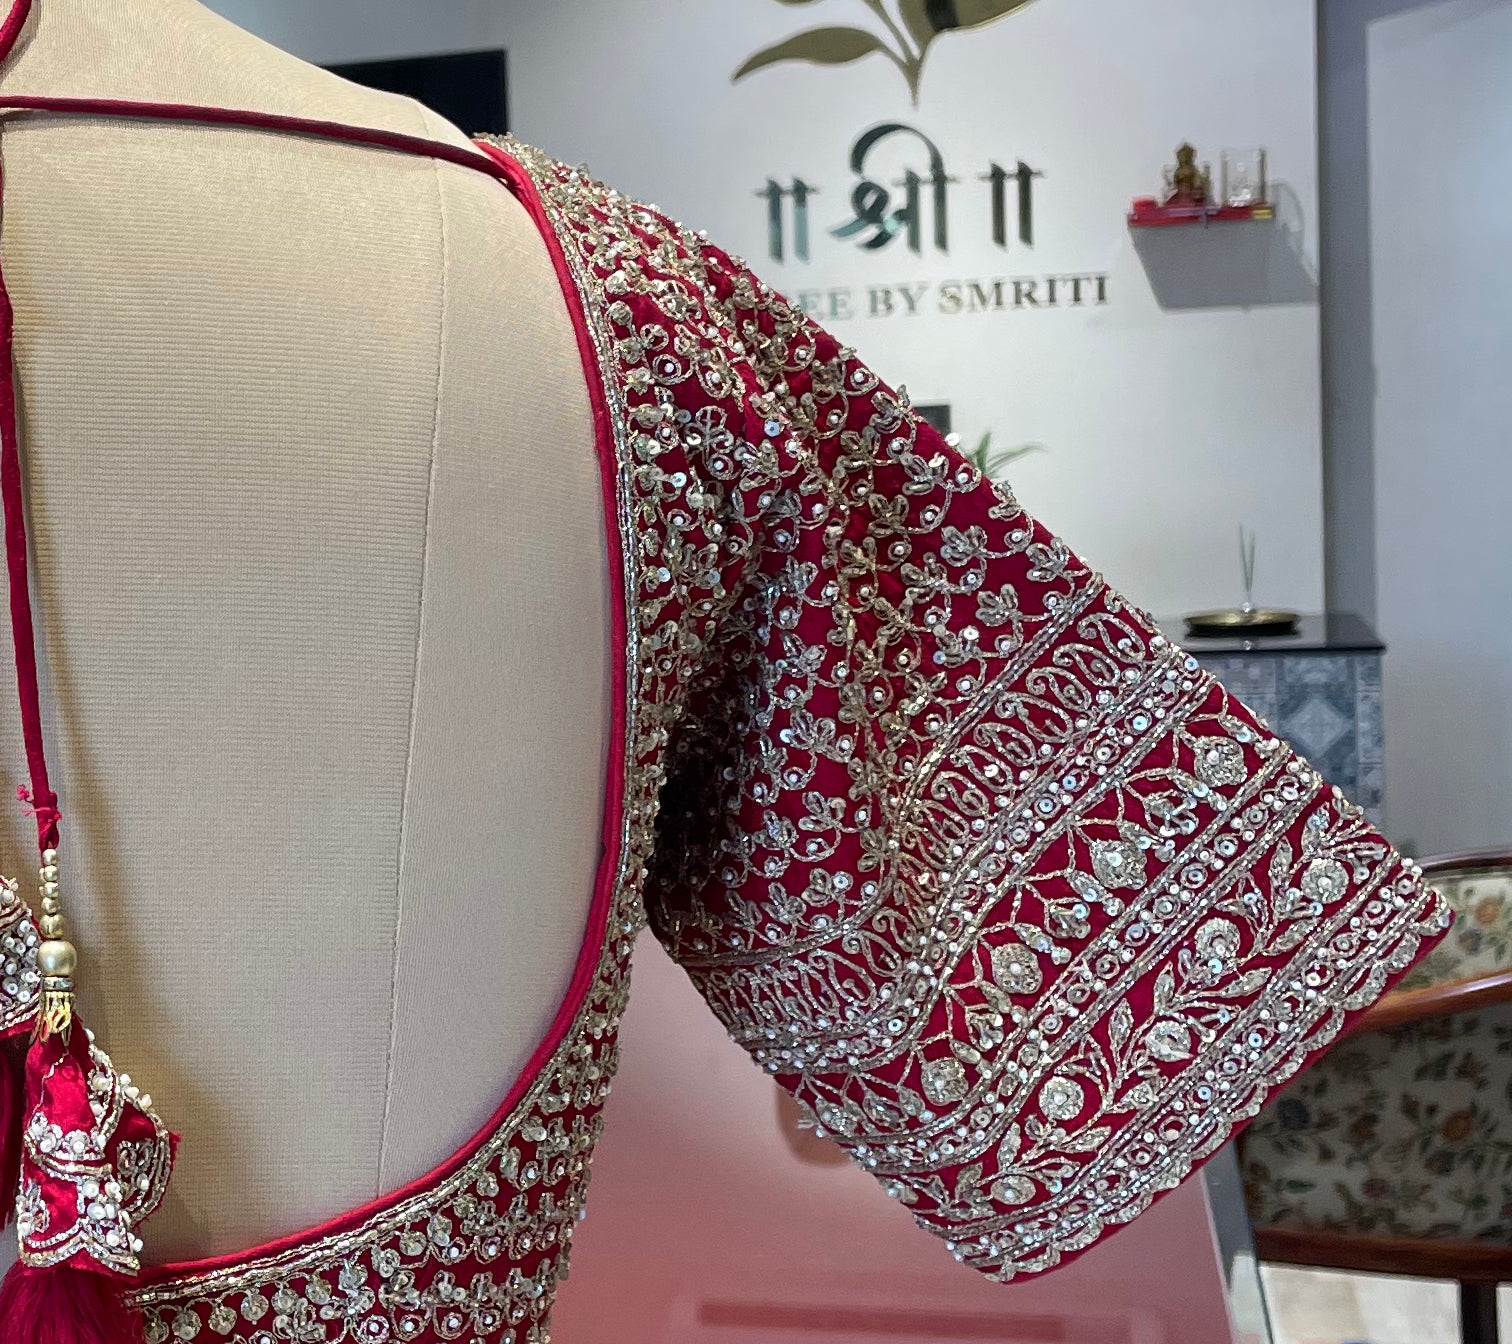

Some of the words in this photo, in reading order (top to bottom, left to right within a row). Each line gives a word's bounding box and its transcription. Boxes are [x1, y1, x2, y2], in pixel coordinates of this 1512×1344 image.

[779, 286, 854, 320] EE
[867, 282, 929, 317] BY
[939, 272, 1110, 314] SMRITI
